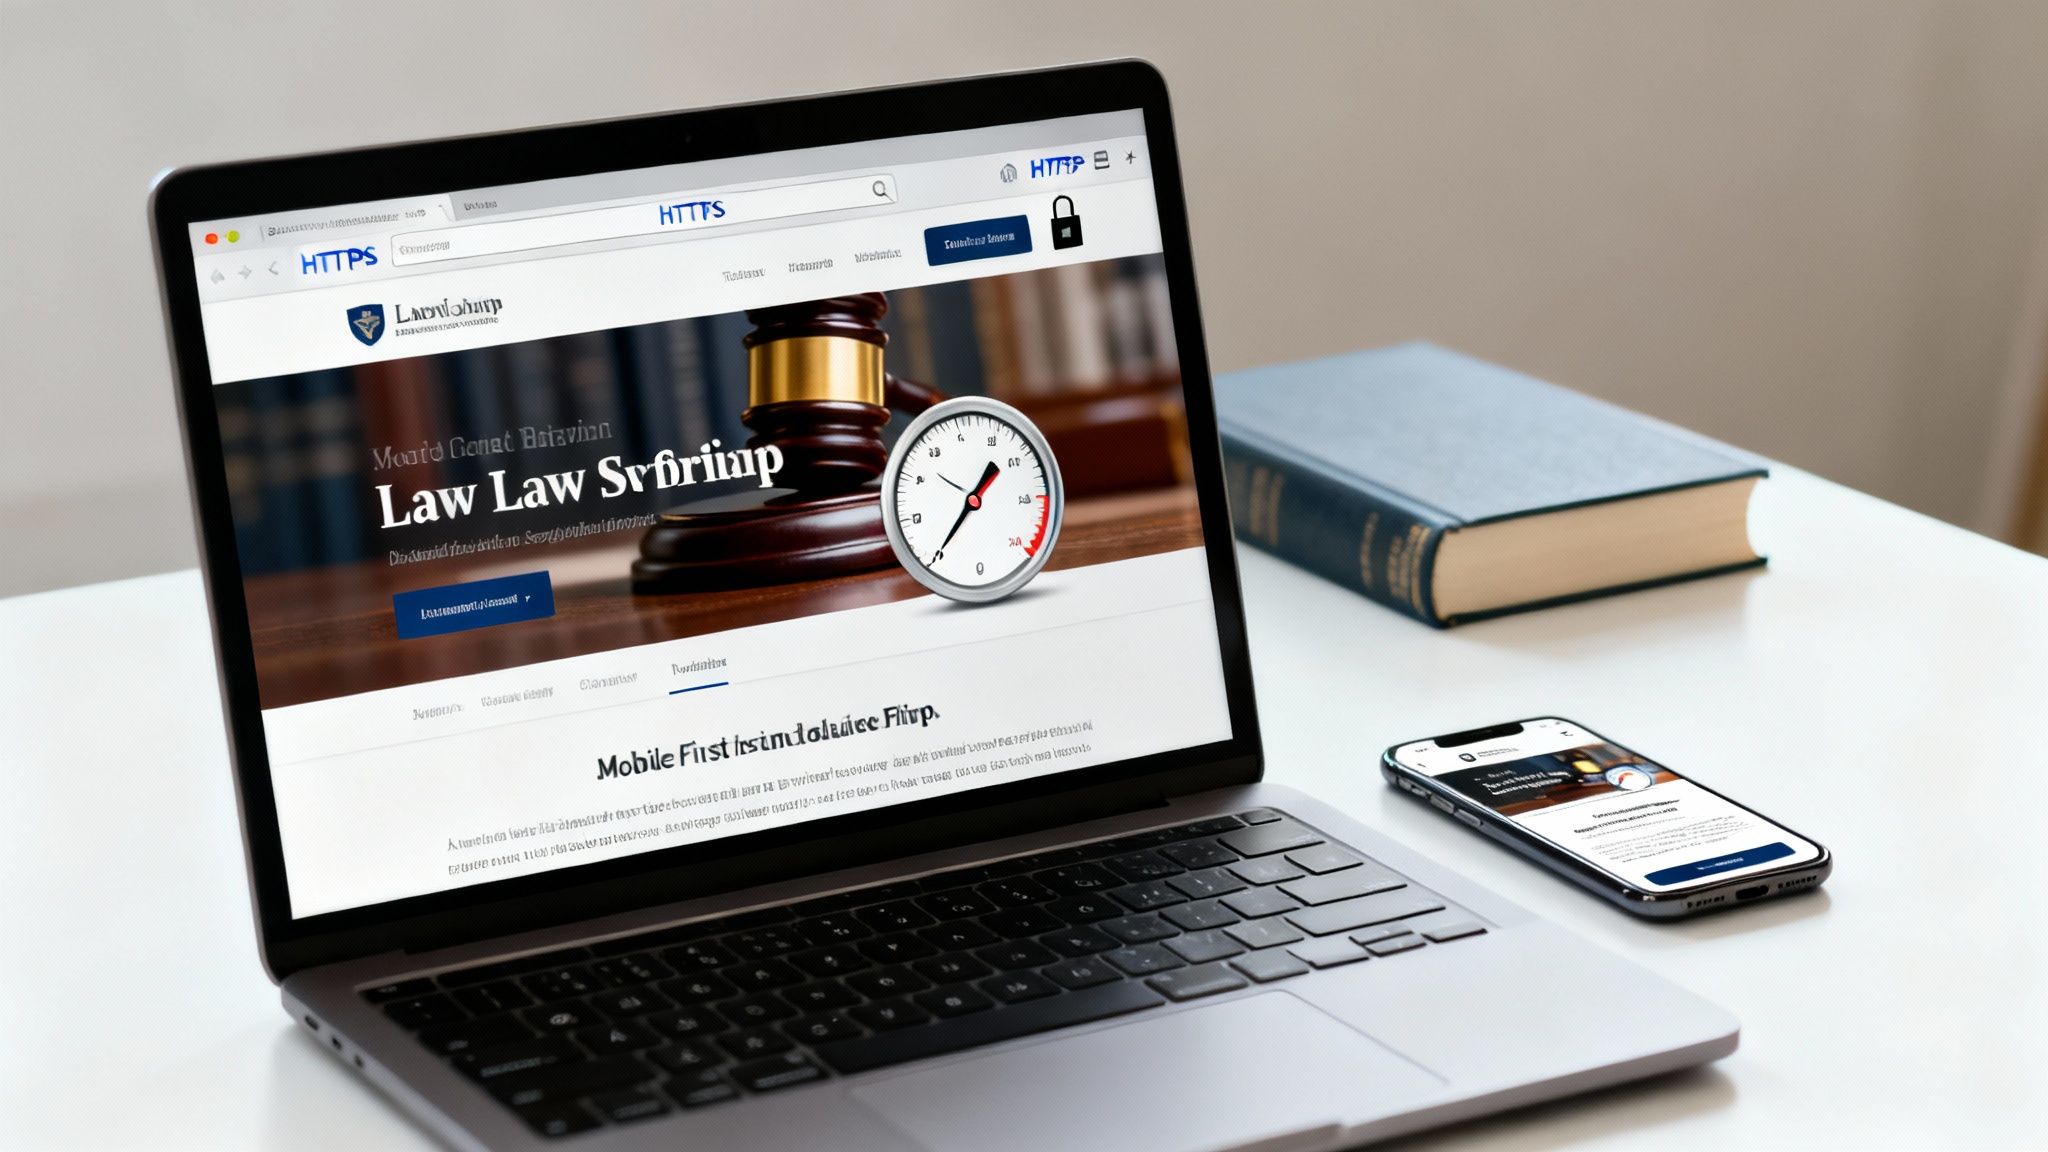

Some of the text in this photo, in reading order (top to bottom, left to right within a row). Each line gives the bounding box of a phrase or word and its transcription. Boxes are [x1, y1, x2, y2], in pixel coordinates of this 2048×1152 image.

[301, 246, 378, 275] HTTPS
[374, 484, 478, 529] Law
[488, 469, 586, 513] Law
[597, 747, 675, 780] Mobile
